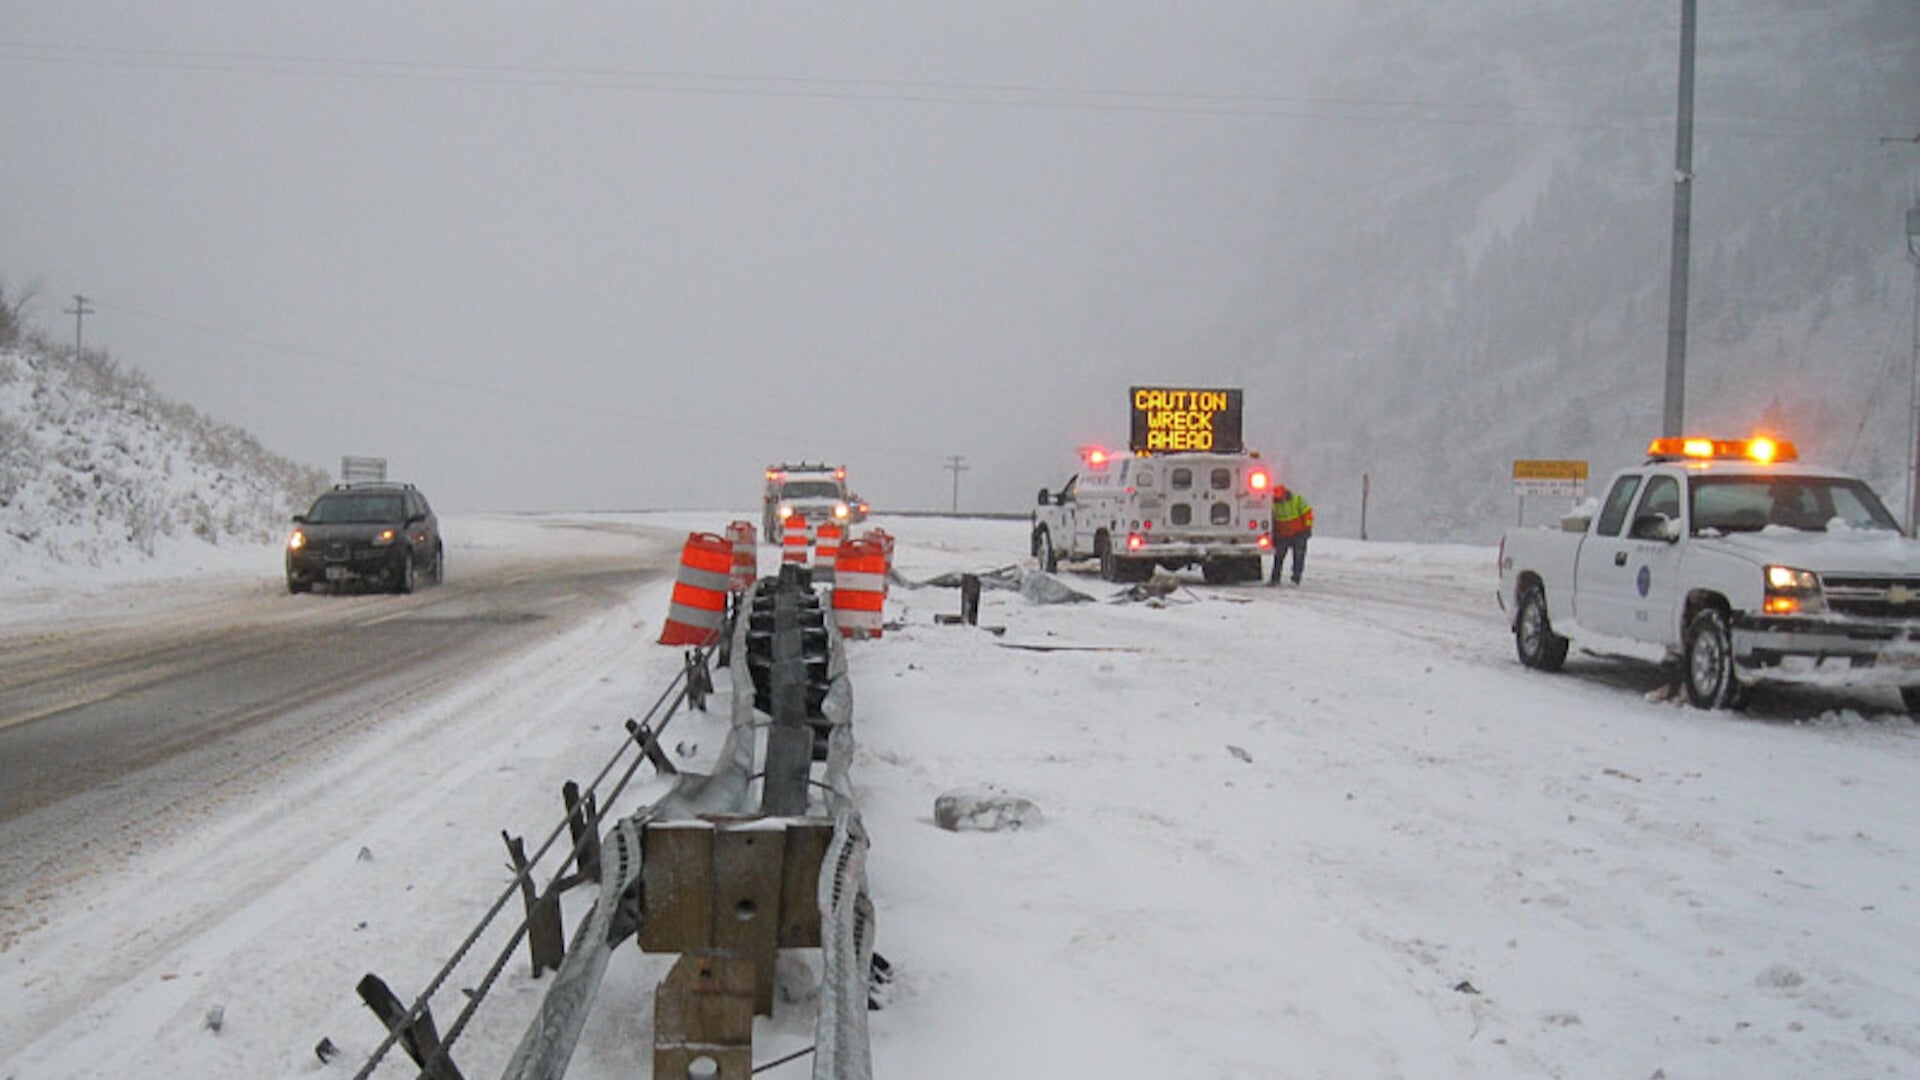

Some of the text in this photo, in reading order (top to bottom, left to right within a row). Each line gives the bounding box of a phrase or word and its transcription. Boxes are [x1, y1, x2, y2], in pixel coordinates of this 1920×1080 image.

[1135, 390, 1227, 411] CAUTION
[1147, 411, 1212, 430] WRECK
[1147, 430, 1212, 449] AHEAD
